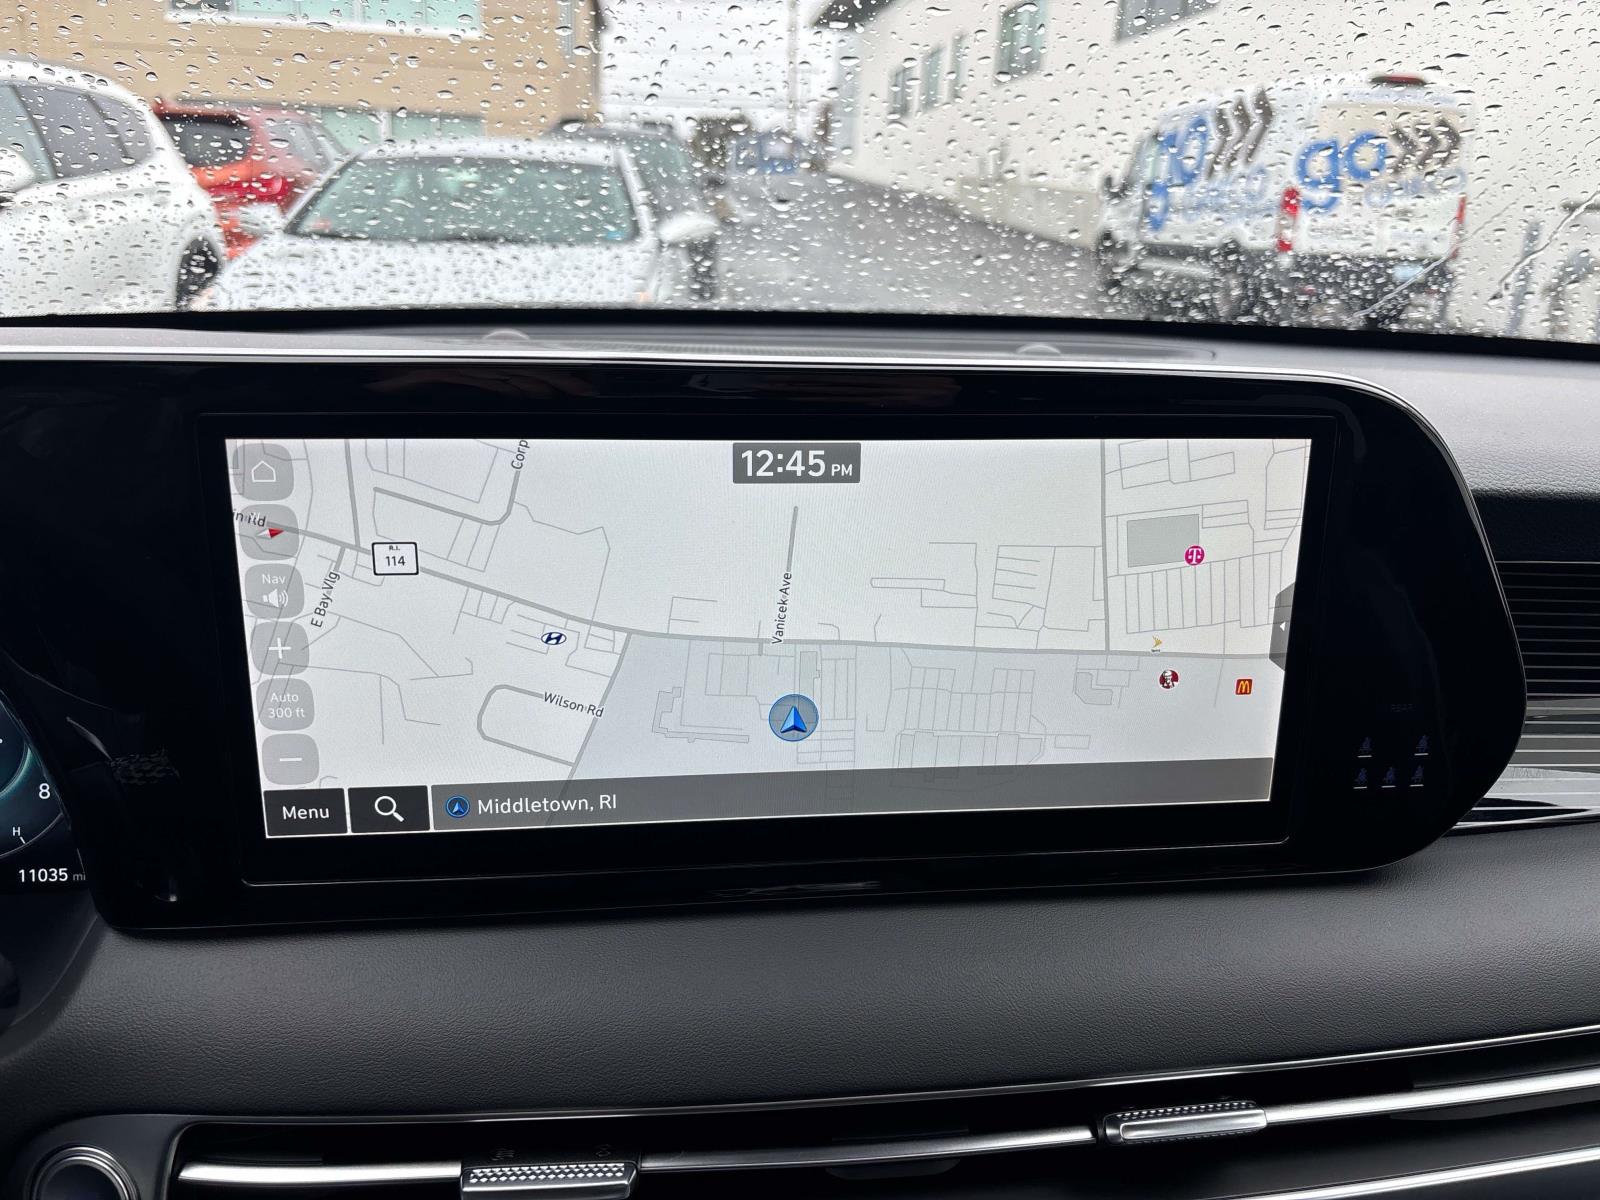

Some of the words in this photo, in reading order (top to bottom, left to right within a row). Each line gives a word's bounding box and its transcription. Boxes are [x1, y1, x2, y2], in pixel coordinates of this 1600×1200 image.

[1296, 130, 1388, 215] go
[511, 439, 531, 470] Corp
[740, 449, 827, 478] 12:45
[831, 463, 854, 477] PM
[385, 555, 406, 567] 114
[261, 573, 287, 585] Nav
[321, 570, 341, 591] Vlg
[779, 571, 793, 596] Ave
[313, 592, 334, 618] Bay
[310, 617, 324, 628] E
[771, 598, 789, 645] Vanicek
[270, 692, 300, 703] Auto
[543, 690, 584, 713] Wilson
[586, 703, 605, 718] Rd
[268, 707, 293, 719] 300
[294, 707, 306, 719] ft
[38, 782, 51, 800] 8
[281, 805, 331, 820] Menu
[477, 797, 595, 815] Middletown,
[599, 793, 618, 810] RI
[12, 825, 21, 837] H
[18, 867, 69, 883] 11035
